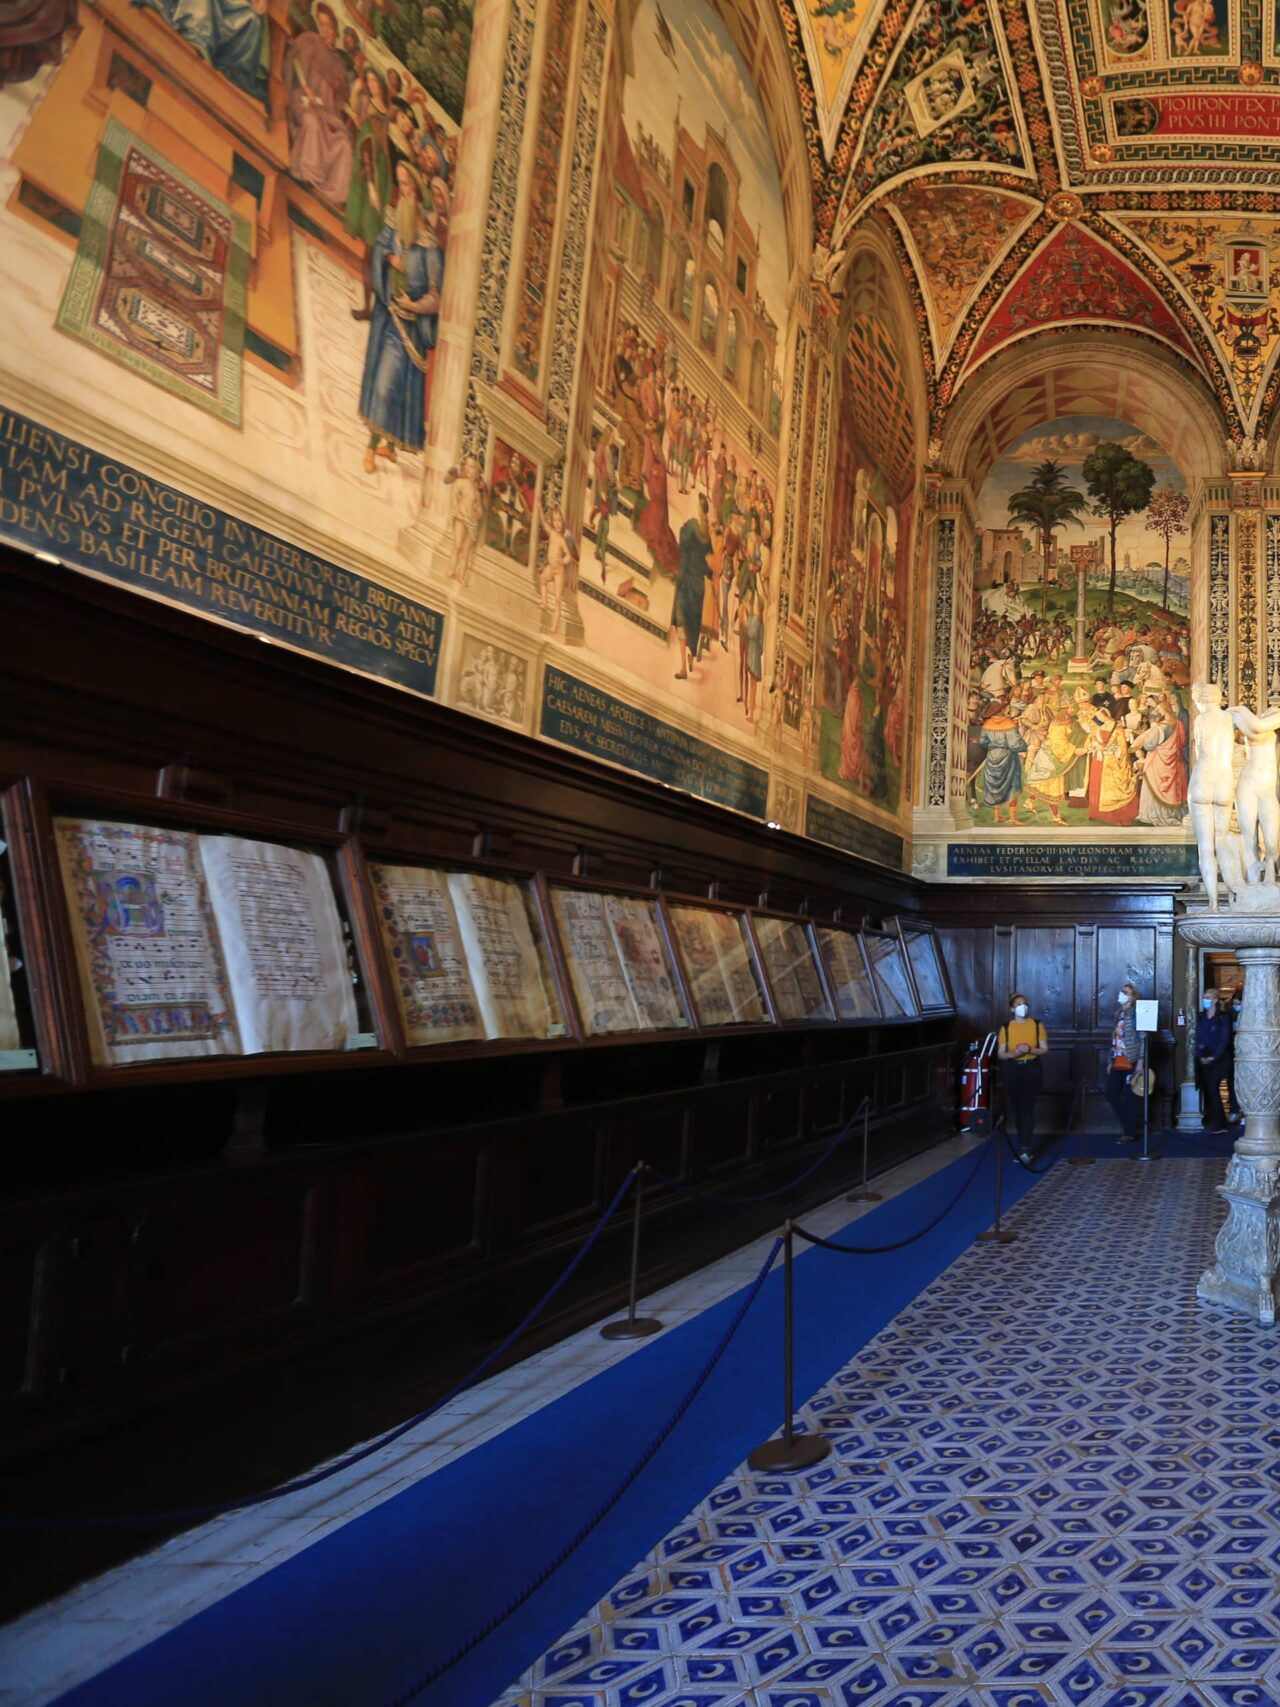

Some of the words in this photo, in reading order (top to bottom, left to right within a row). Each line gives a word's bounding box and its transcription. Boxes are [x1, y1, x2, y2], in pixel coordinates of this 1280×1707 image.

[1168, 114, 1206, 129] PIVS
[1209, 114, 1227, 129] III
[1245, 98, 1266, 113] EX
[0, 440, 68, 492] IAM
[79, 476, 122, 515] AD
[130, 499, 213, 554] REGEM
[332, 589, 388, 629] MISSVS
[99, 460, 217, 533] CONCILIO
[223, 518, 245, 545] IN
[366, 585, 436, 631] BRITANNI
[18, 477, 112, 536] PVLSVS
[121, 520, 150, 552] ET
[157, 536, 201, 572] PER
[205, 556, 330, 625] BRITANNIAM
[335, 612, 391, 650] REGIOS
[394, 637, 436, 668] SPECV
[78, 529, 202, 596] BASILEAM
[546, 693, 597, 726] CAESAREM
[548, 674, 568, 694] HIC
[571, 685, 605, 711] AENEAS
[559, 719, 580, 739] EIVS
